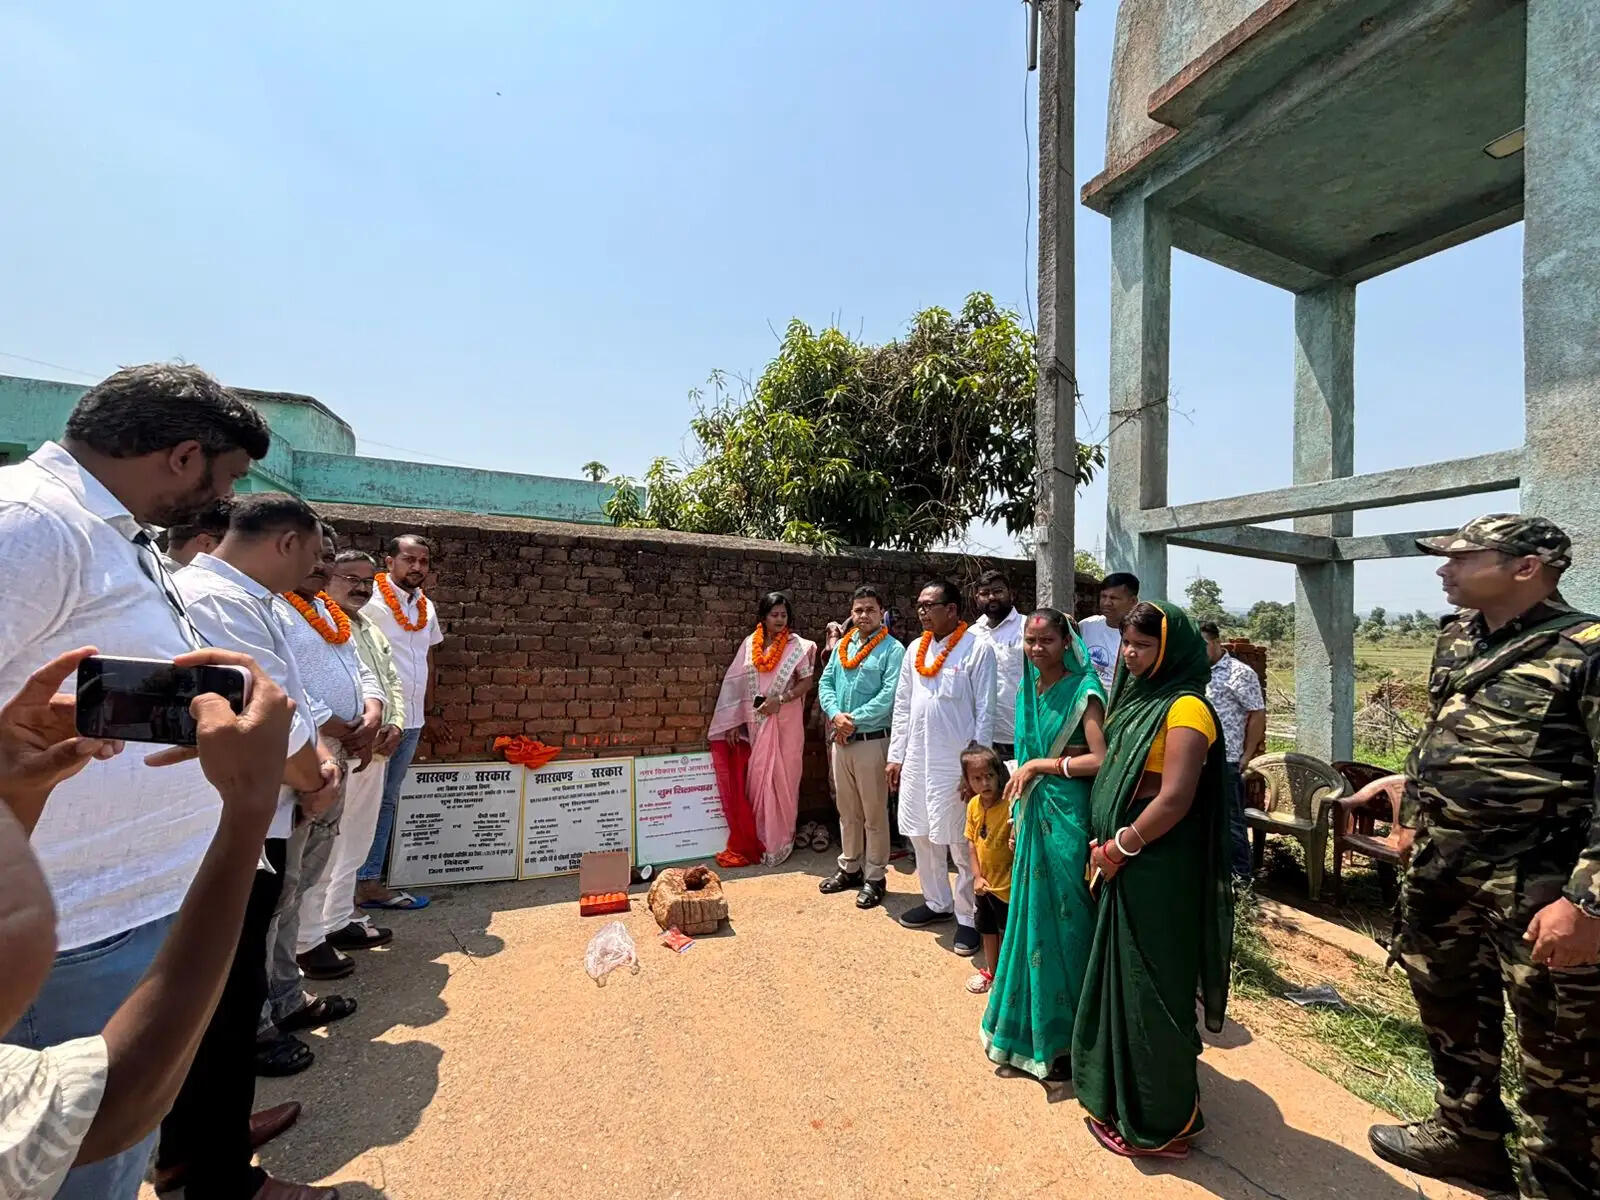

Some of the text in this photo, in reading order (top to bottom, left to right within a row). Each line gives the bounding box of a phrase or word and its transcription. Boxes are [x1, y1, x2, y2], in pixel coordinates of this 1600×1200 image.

[416, 770, 512, 784] झारखण्ड सरकार
[534, 771, 573, 784] झारखण्ड
[591, 766, 623, 778] सरकार
